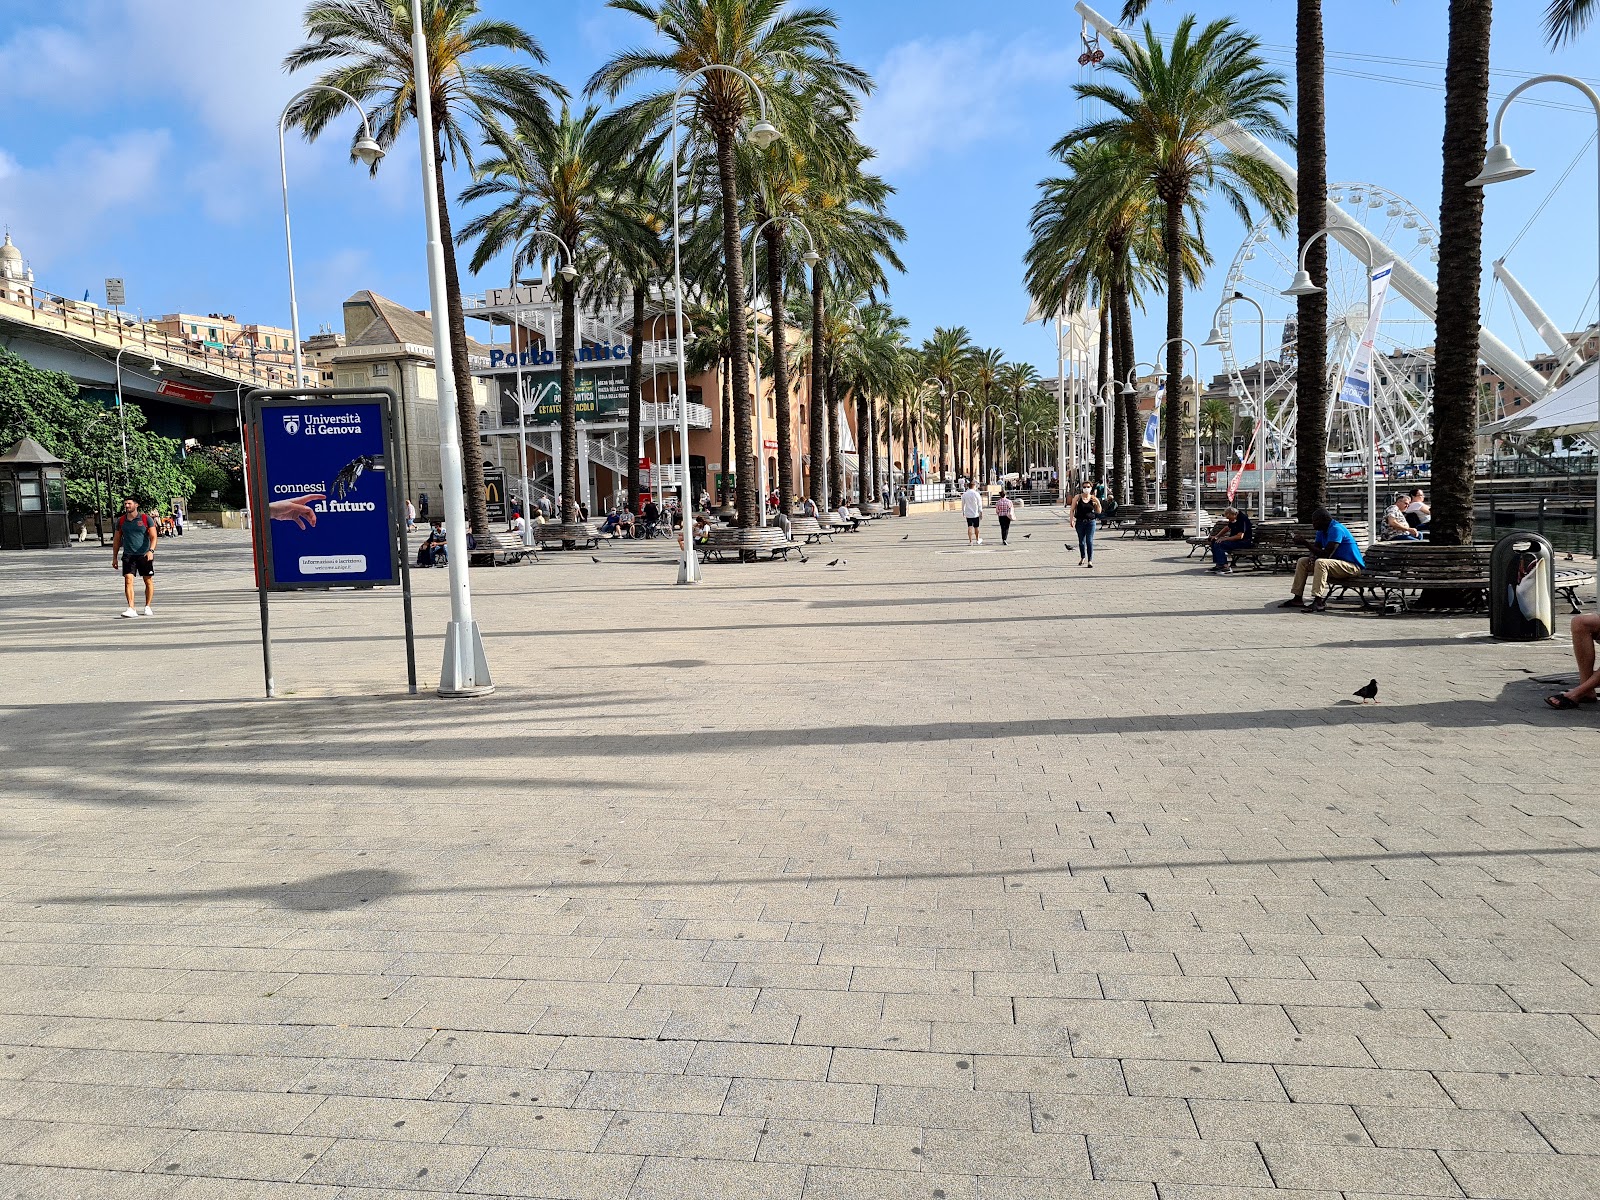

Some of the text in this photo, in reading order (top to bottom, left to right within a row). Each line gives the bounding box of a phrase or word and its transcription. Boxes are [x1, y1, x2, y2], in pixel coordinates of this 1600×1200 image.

[490, 347, 553, 368] Porto
[304, 413, 361, 424] Università
[305, 425, 362, 435] di Genova
[274, 481, 326, 494] connessi
[315, 500, 375, 512] al futuro
